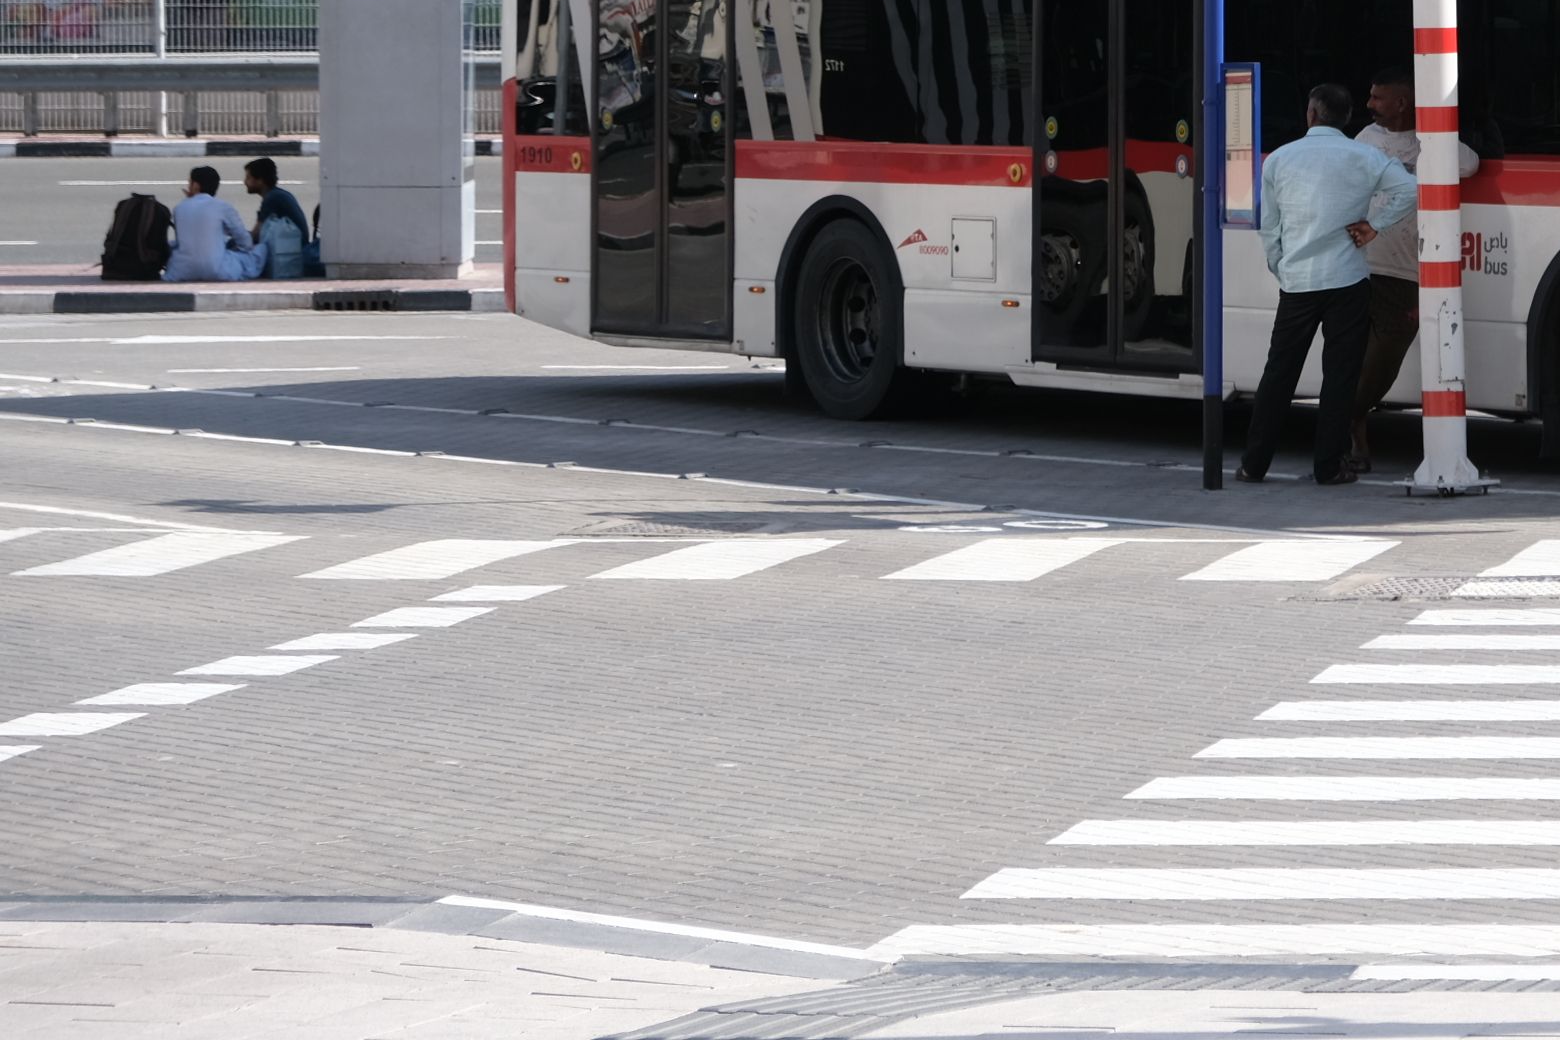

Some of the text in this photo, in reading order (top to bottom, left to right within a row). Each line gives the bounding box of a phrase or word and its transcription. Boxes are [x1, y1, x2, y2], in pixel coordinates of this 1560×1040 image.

[521, 147, 552, 164] 1910
[1484, 232, 1507, 254] باص
[1484, 256, 1508, 275] bus
